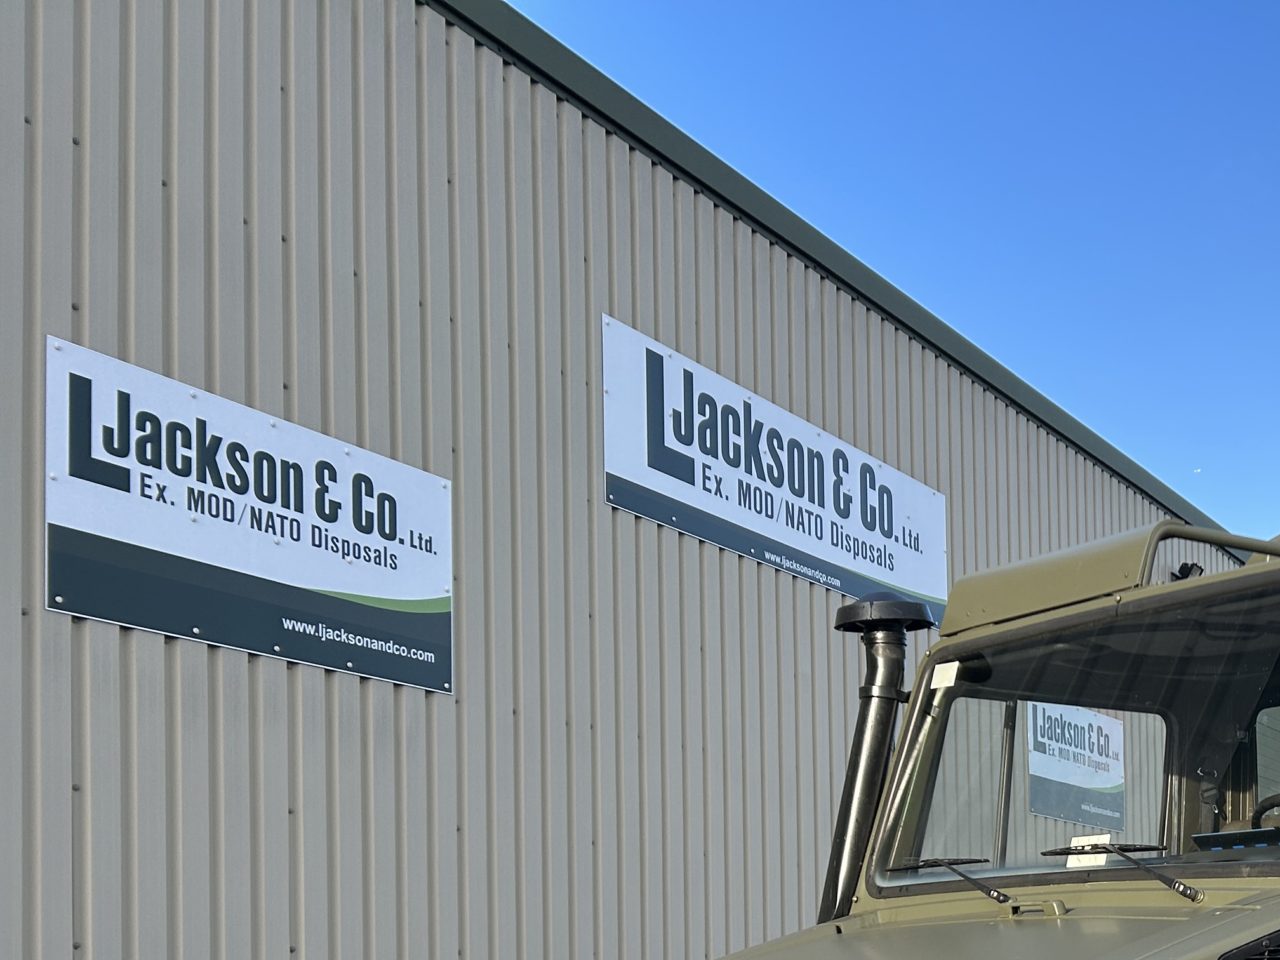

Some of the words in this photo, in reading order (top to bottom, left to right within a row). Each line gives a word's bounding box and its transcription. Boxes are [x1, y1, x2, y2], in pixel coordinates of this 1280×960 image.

[139, 471, 176, 507] Ex.
[311, 525, 399, 571] Disposals
[314, 459, 342, 523] &
[352, 472, 405, 545] Co.
[409, 529, 438, 556] Ltd.
[701, 464, 730, 501] Ex.
[830, 519, 895, 572] Disposals
[832, 447, 853, 520] &
[859, 462, 899, 543] Co.
[902, 526, 924, 554] Ltd.
[1087, 722, 1095, 754] &
